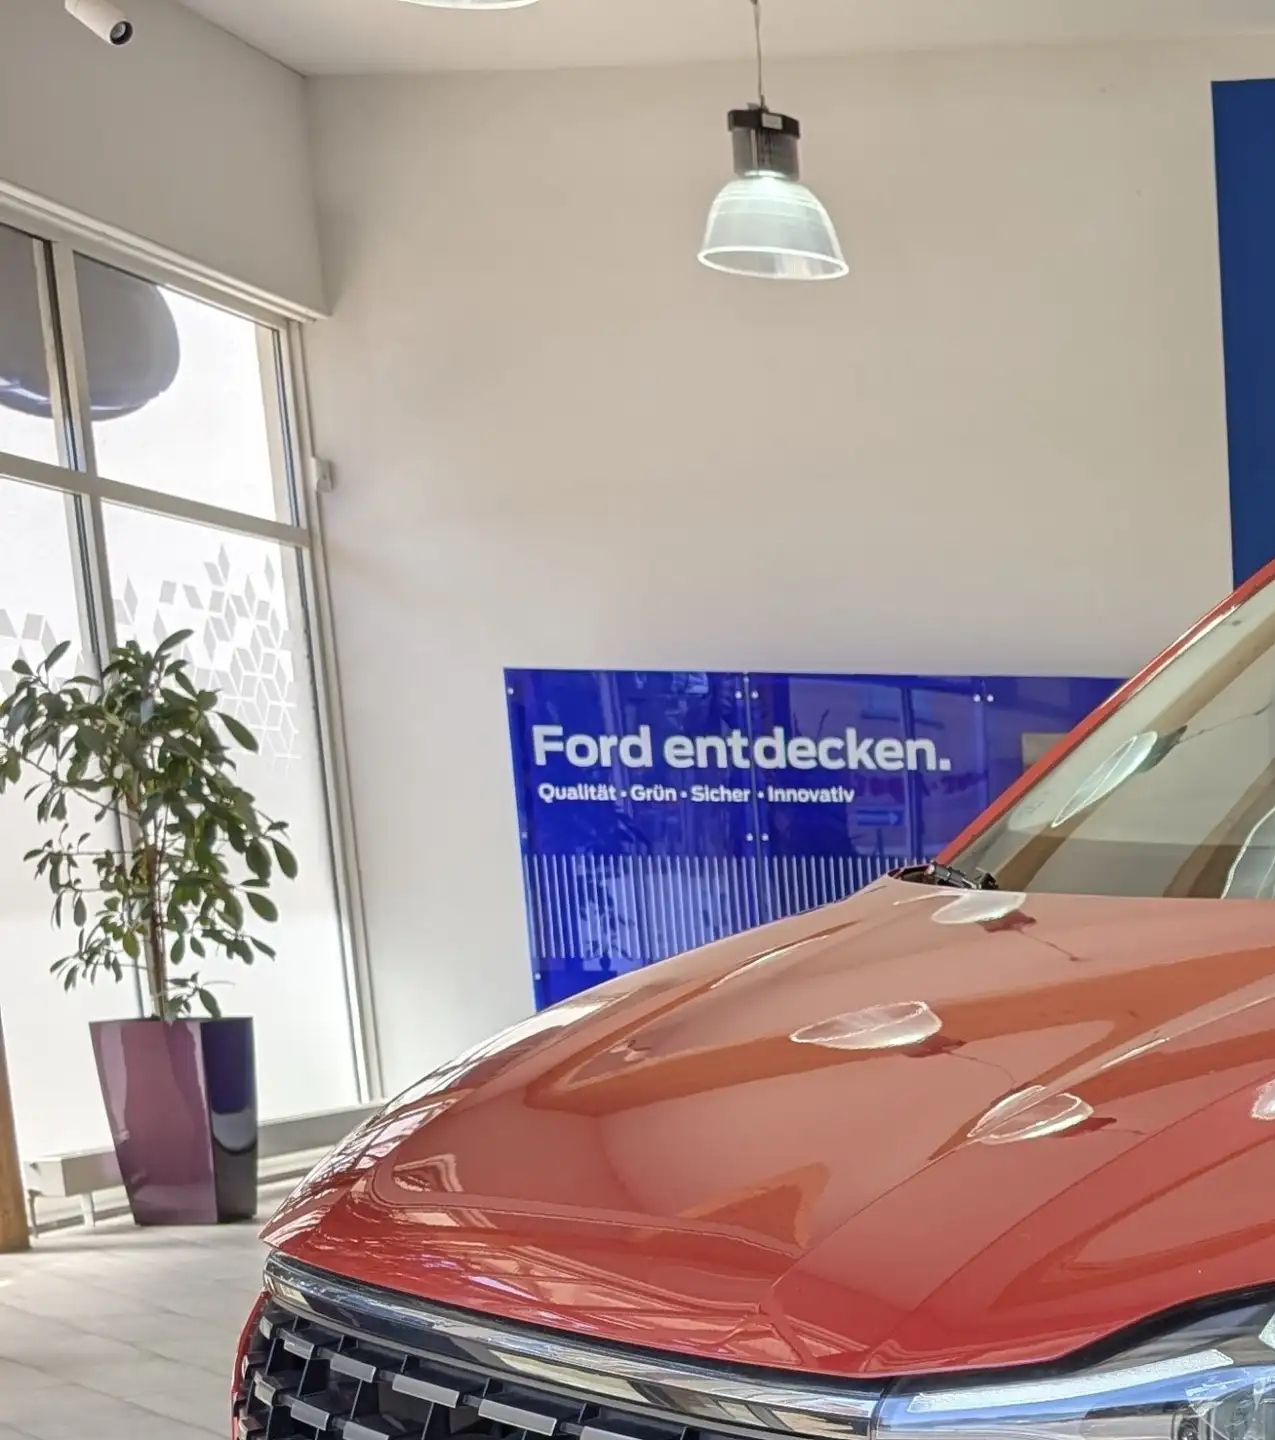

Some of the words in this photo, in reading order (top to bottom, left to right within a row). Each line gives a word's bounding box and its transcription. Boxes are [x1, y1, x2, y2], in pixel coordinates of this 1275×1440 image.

[531, 724, 654, 768] Ford
[663, 725, 952, 772] entdecken.
[537, 783, 617, 803] Qualität
[629, 784, 678, 802] Grün
[690, 785, 751, 803] Sicher
[766, 785, 856, 803] Innovativ
